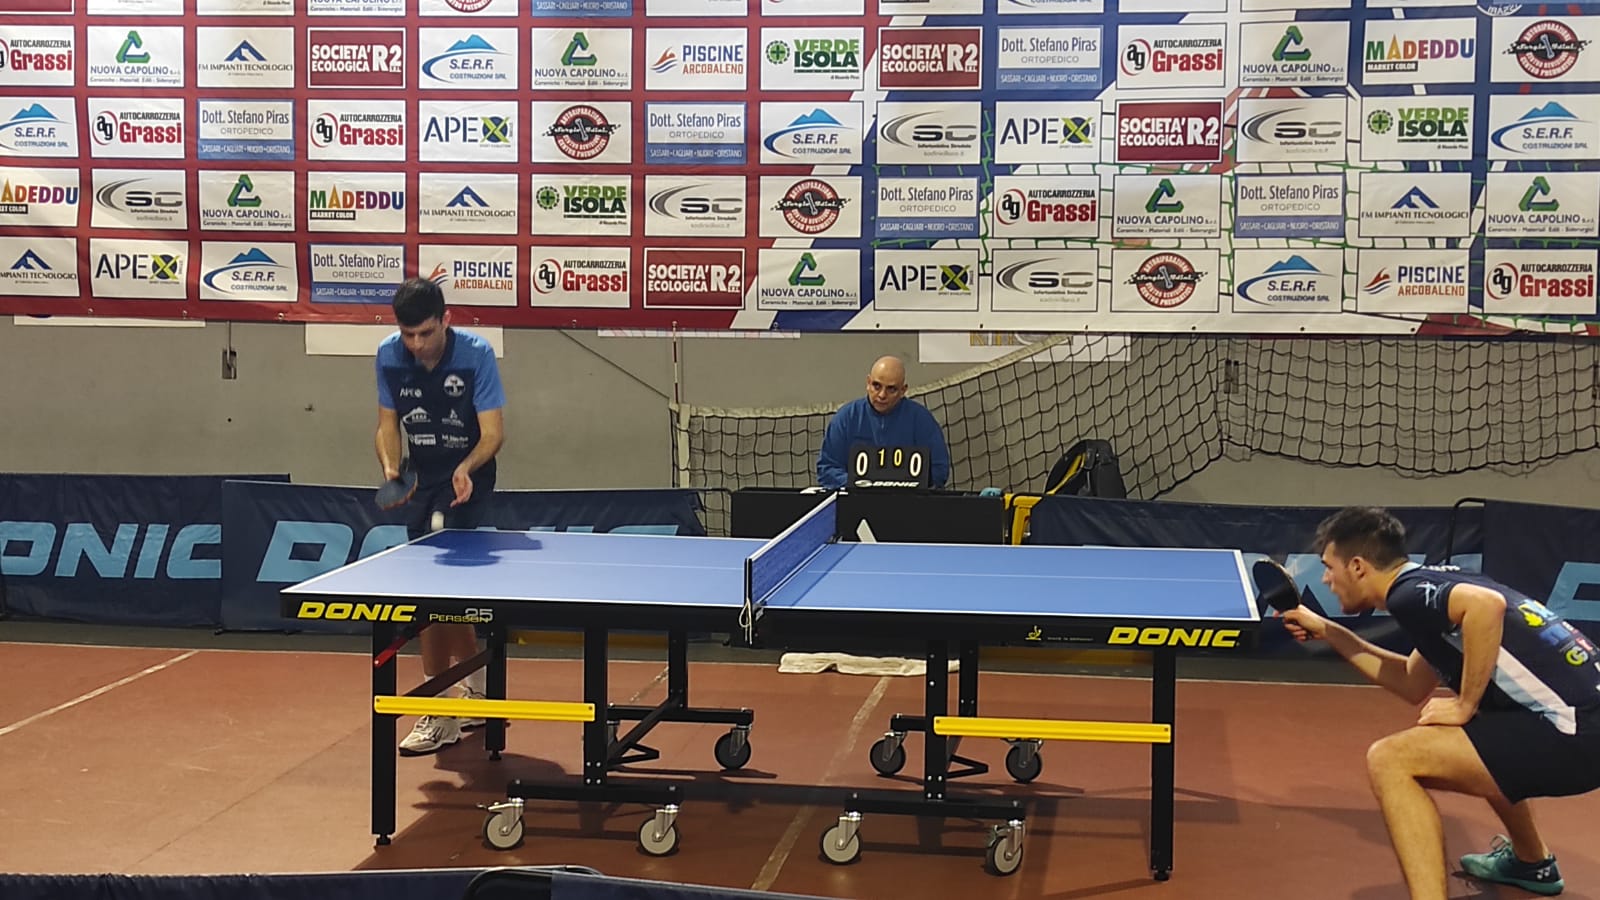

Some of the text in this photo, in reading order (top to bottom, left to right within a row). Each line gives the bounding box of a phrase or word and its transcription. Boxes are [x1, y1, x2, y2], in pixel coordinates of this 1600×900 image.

[10, 40, 71, 48] AUTOCARROZZERIA
[794, 39, 859, 51] VERDE
[1002, 37, 1096, 52] Dott. Stefano Piras
[1154, 39, 1222, 48] AUTOCARROZZERIA
[1366, 34, 1474, 60] MADEDDU
[372, 45, 401, 71] R2
[683, 45, 743, 62] PISCINE
[794, 52, 857, 67] ISOLA
[946, 44, 977, 71] R2
[1021, 55, 1079, 63] ORTOPEDICO
[10, 50, 72, 71] Grassi
[312, 62, 369, 72] ECOLOGICA
[450, 59, 493, 69] S.E.R.F.
[882, 61, 943, 72] ECOLOGICA
[1153, 50, 1223, 72] Grassi
[90, 66, 168, 75] NUOVA CAPOLINO
[535, 69, 615, 77] NUOVA CAPOLINO
[683, 65, 743, 74] ARCOBALENO
[1243, 64, 1330, 73] NUOVA CAPOLINO
[119, 112, 181, 121] AUTOCARROZZERIA
[202, 109, 289, 124] Dott. Stefano Piras
[340, 114, 402, 122] AUTOCARROZZERIA
[650, 112, 741, 127] Dott. Stefano Piras
[1398, 108, 1469, 122] VERDE
[15, 127, 56, 138] S.E.R.F.
[119, 123, 181, 144] Grassi
[340, 125, 403, 145] Grassi
[424, 116, 510, 144] APEX
[669, 131, 724, 139] ORTOPEDICO
[1000, 117, 1094, 144] APEX
[1187, 117, 1219, 145] R2
[1398, 120, 1467, 137] ISOLA
[1522, 127, 1573, 139] S.E.R.F.
[792, 134, 837, 144] S.E.R.F.
[1120, 134, 1184, 146] ECOLOGICA
[2, 178, 78, 205] ADEDDU
[310, 185, 404, 209] MADEDDU
[563, 185, 626, 198] VERDE
[880, 187, 973, 201] Dott. Stefano Piras
[1028, 189, 1095, 198] AUTOCARROZZERIA
[1240, 184, 1338, 200] Dott. Stefano Piras
[564, 197, 626, 212] ISOLA
[899, 204, 956, 212] ORTOPEDICO
[1027, 200, 1096, 222] Grassi
[1260, 203, 1320, 212] ORTOPEDICO
[203, 209, 279, 218] NUOVA CAPOLINO
[1117, 215, 1203, 225] NUOVA CAPOLINO
[1413, 211, 1468, 219] TECNOLOGICI
[1488, 214, 1580, 223] NUOVA CAPOLINO
[95, 254, 180, 280] APEX
[314, 253, 399, 268] Dott. Stefano Piras
[563, 260, 626, 269] AUTOCARROZZERIA
[454, 260, 512, 278] PISCINE
[1398, 266, 1465, 283] PISCINE
[1521, 264, 1592, 272] AUTOCARROZZERIA
[232, 271, 275, 282] S.E.R.F.
[332, 271, 384, 279] ORTOPEDICO
[563, 271, 627, 292] Grassi
[710, 264, 740, 291] R2
[879, 264, 970, 290] APEX
[454, 279, 512, 290] ARCOBALENO
[648, 281, 708, 292] ECOLOGICA
[1267, 280, 1315, 291] S.E.R.F.
[1398, 285, 1465, 296] ARCOBALENO
[1520, 274, 1594, 297] Grassi
[761, 288, 843, 298] NUOVA CAPOLINO
[856, 449, 922, 477] 0 1 0 0
[0, 520, 222, 579] ONIC
[297, 601, 417, 621] DONIC
[1108, 627, 1240, 647] DONIC
